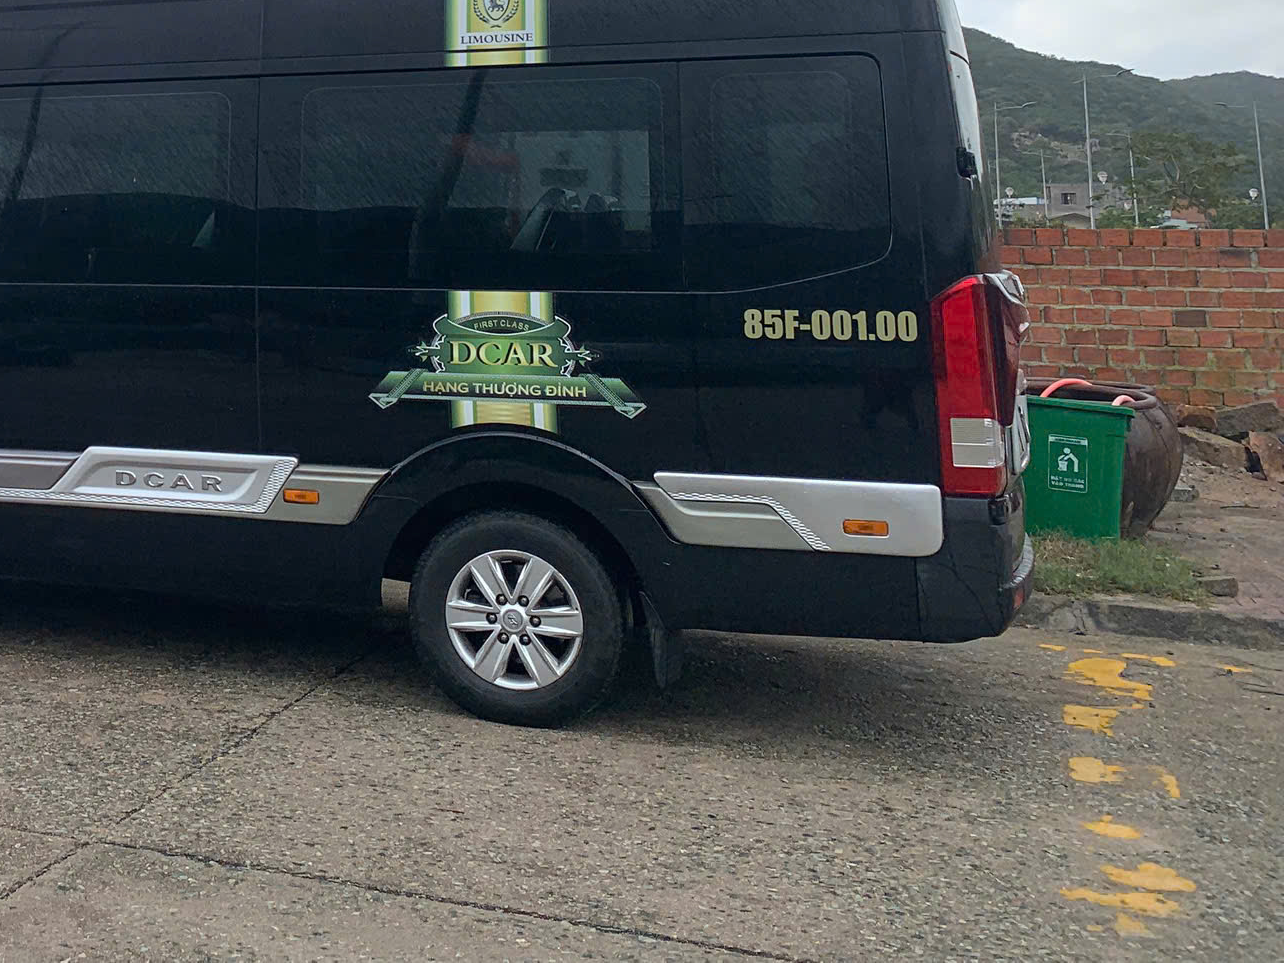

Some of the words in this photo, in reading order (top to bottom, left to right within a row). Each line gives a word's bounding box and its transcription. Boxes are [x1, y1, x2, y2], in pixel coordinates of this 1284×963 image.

[460, 32, 534, 45] LIMOUSINE
[473, 319, 498, 331] FIRST
[499, 319, 530, 332] CLASS
[743, 308, 918, 342] 85F-001.00
[448, 340, 558, 368] DCAR
[422, 381, 469, 395] HẠNG
[472, 380, 542, 397] THƯỢNG
[115, 469, 223, 492] DCAR
